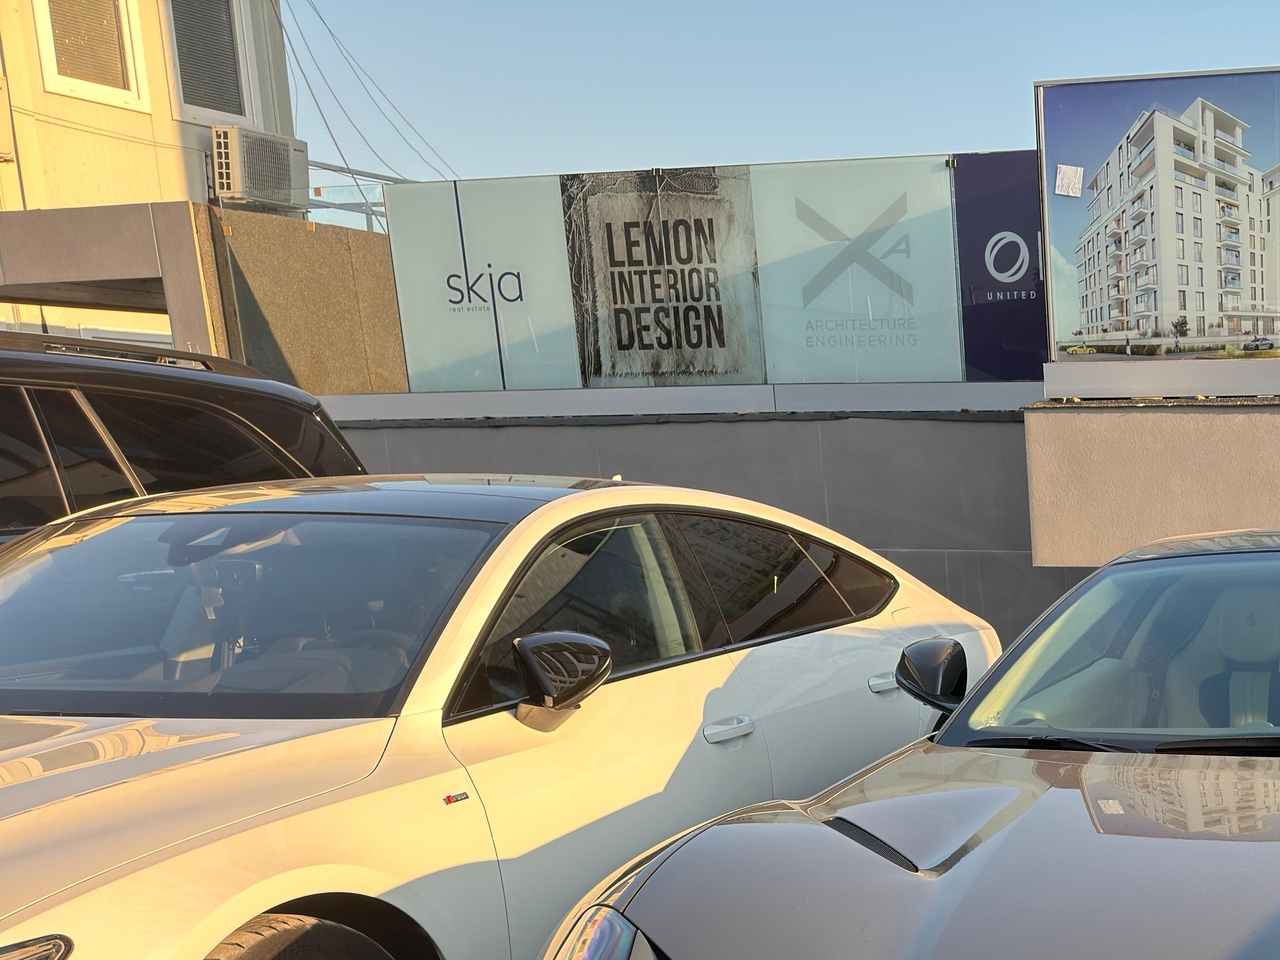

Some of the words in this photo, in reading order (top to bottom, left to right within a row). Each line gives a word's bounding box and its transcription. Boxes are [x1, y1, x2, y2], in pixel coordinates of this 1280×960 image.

[605, 217, 717, 268] LEMON
[610, 267, 720, 305] INTERIOR
[986, 290, 1037, 301] UNITED
[613, 304, 726, 351] DESIGN
[804, 317, 916, 333] ARCHITECTURE
[805, 333, 918, 348] ENGINEERING
